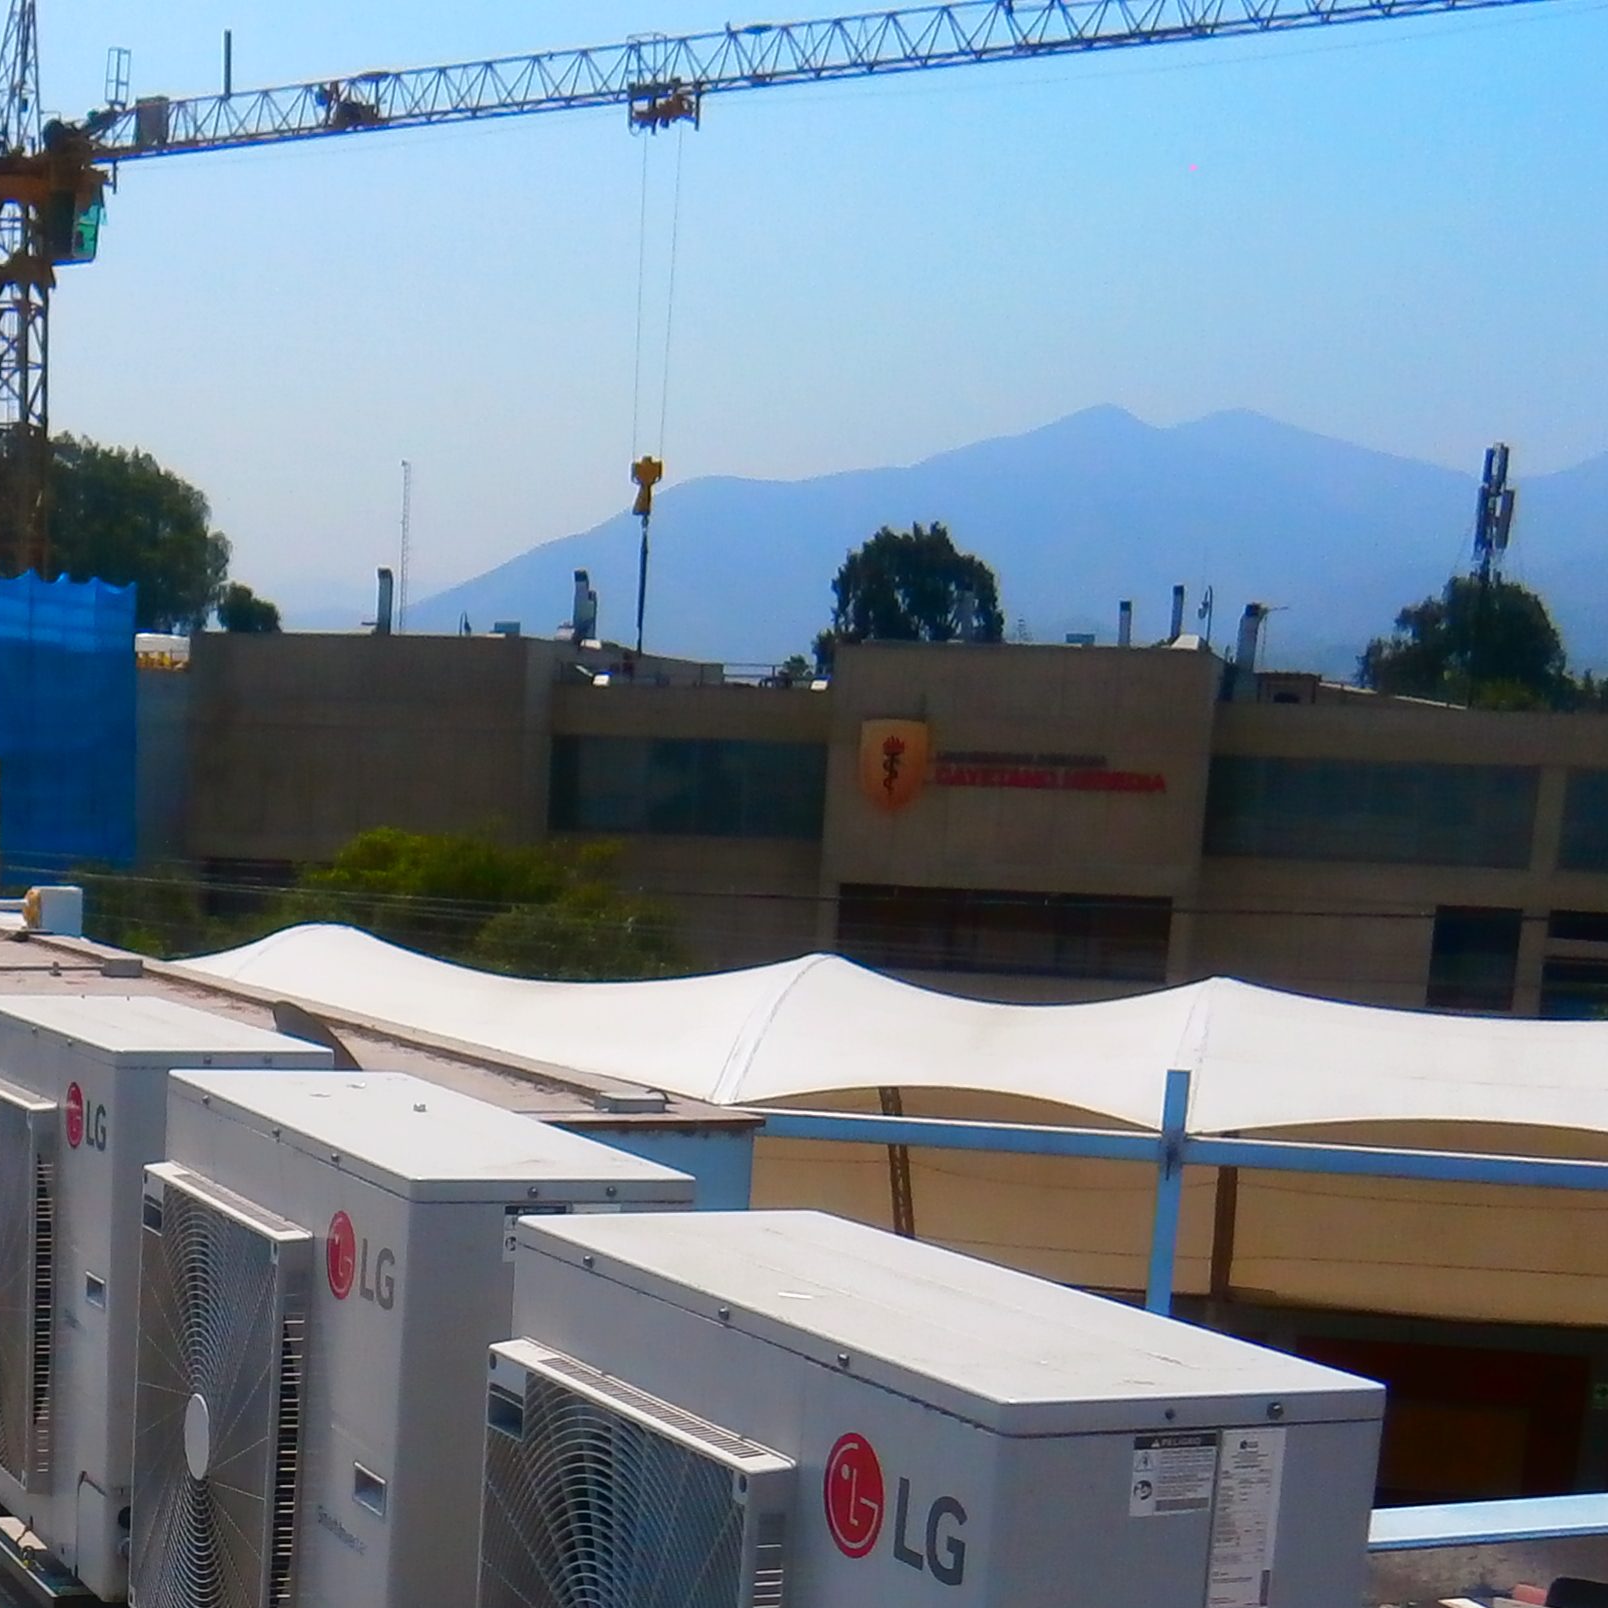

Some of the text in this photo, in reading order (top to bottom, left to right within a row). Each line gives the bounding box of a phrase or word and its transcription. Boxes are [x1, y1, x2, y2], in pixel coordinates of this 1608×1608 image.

[86, 1100, 106, 1152] LG
[359, 1237, 395, 1310] LG
[894, 1477, 968, 1586] LG
